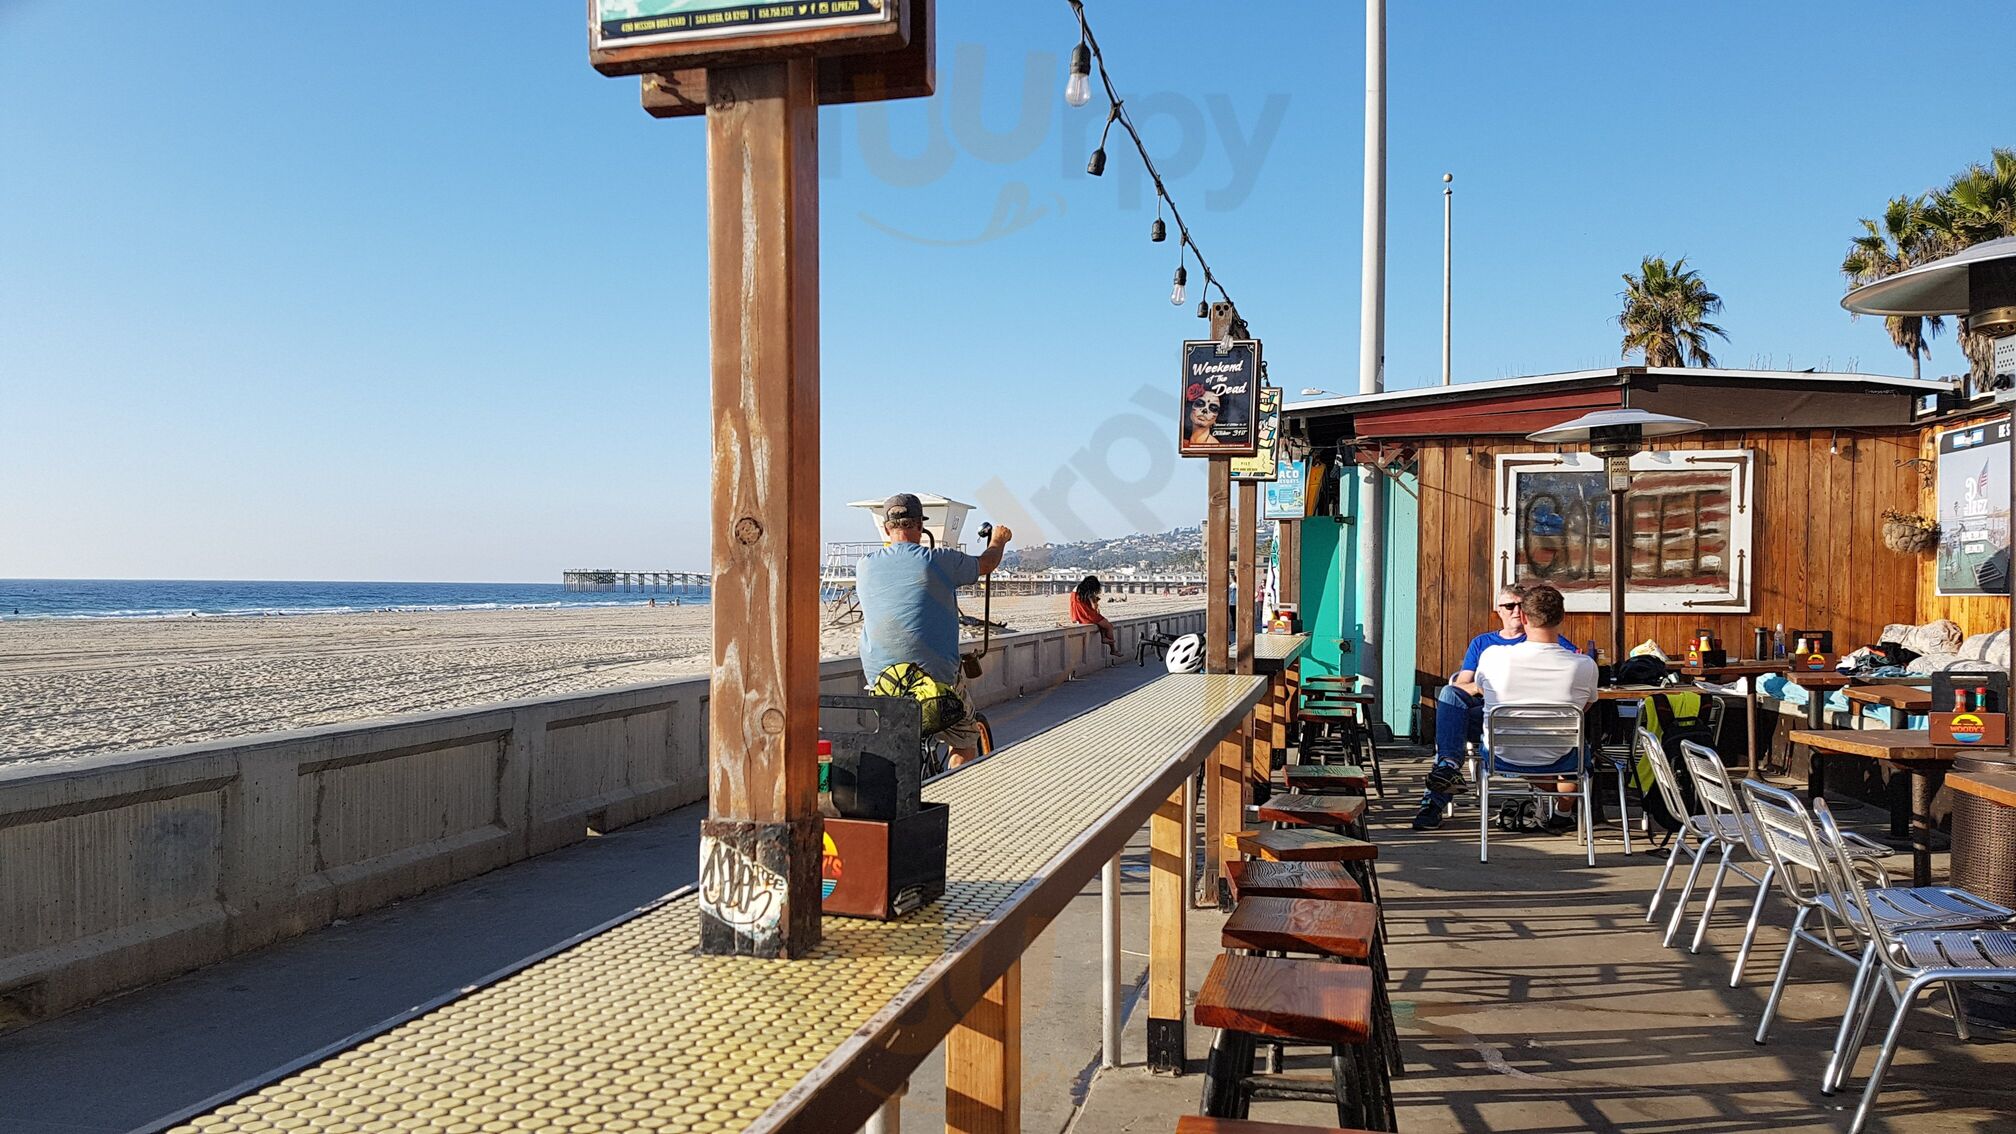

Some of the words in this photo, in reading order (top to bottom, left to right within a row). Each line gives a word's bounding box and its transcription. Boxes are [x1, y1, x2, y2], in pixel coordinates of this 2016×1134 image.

[634, 20, 656, 31] MISSION
[656, 16, 686, 29] BOULEVARD
[695, 14, 707, 25] SAN
[724, 11, 732, 22] CA
[1193, 360, 1243, 376] Weekend
[1206, 375, 1215, 385] of
[1211, 382, 1247, 397] Dead
[1279, 470, 1299, 479] ACO
[1949, 725, 1985, 733] WOODY'S
